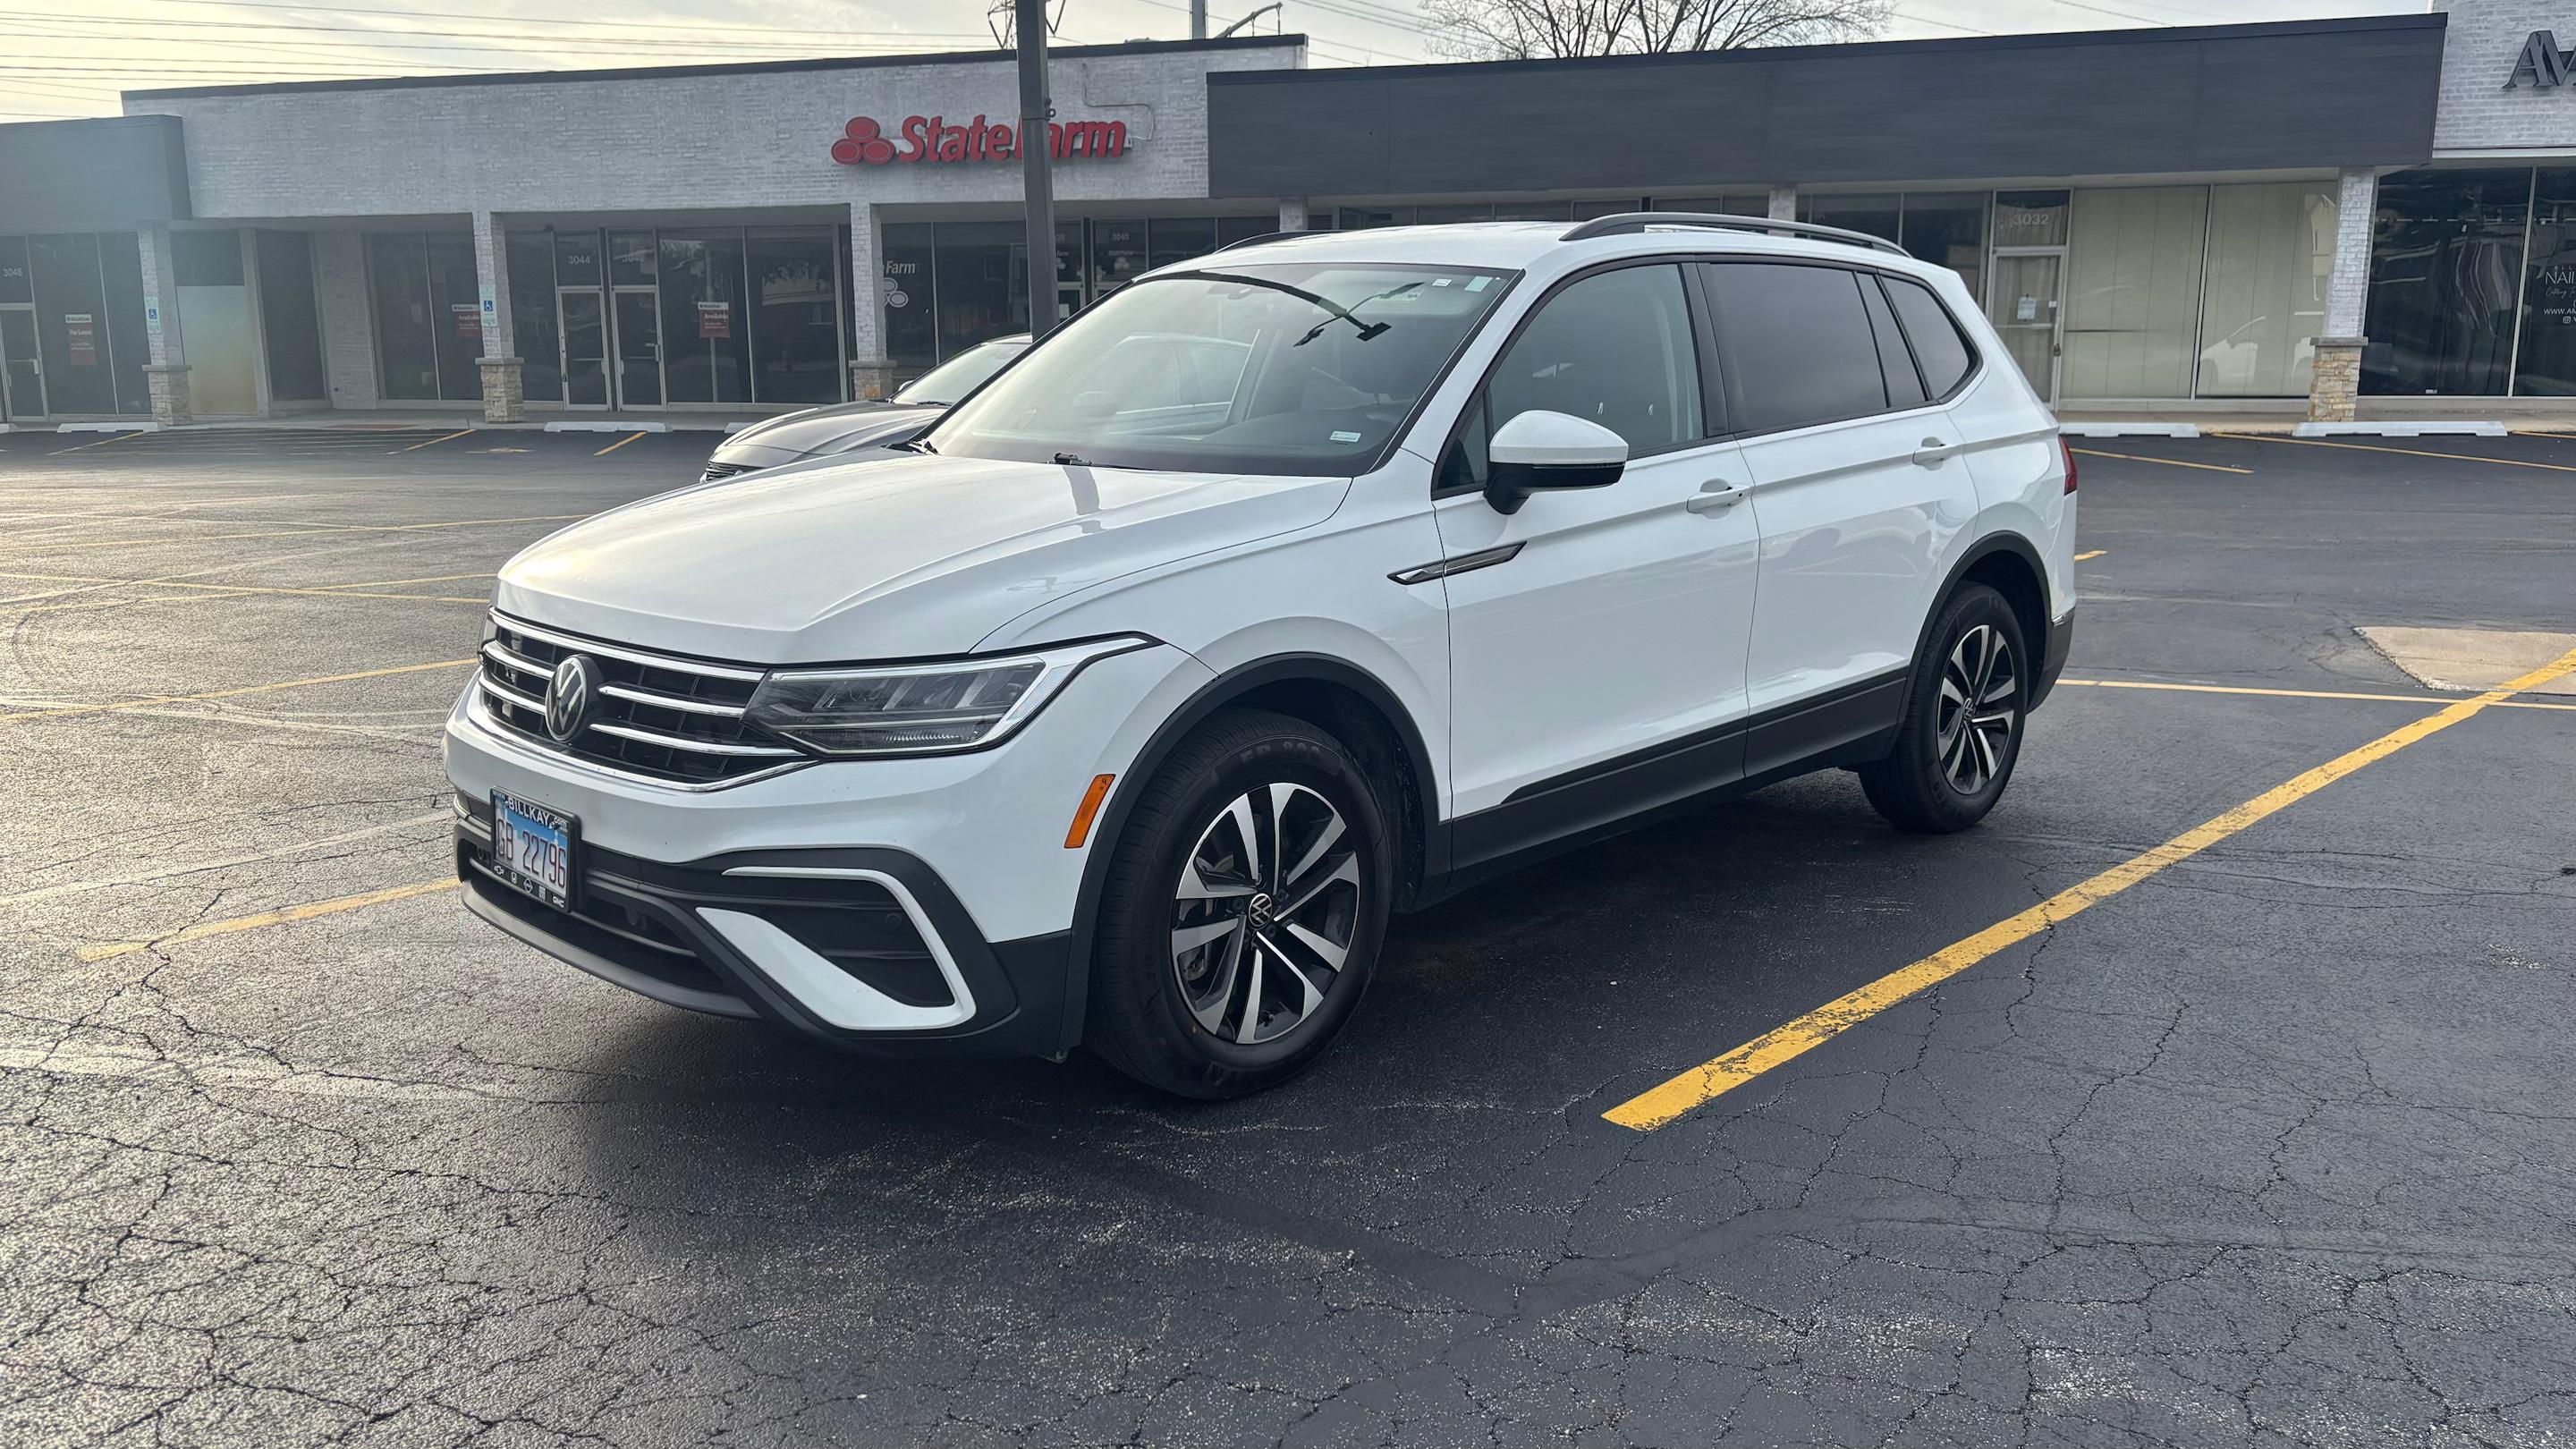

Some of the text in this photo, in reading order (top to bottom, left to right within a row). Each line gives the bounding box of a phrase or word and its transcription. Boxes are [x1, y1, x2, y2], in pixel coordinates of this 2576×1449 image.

[2013, 214, 2049, 225] 3032
[1112, 233, 1130, 241] 3040
[568, 256, 590, 265] 3044
[886, 260, 916, 275] Farm
[507, 796, 551, 826] BILLKAY
[497, 819, 567, 888] GB 22796
